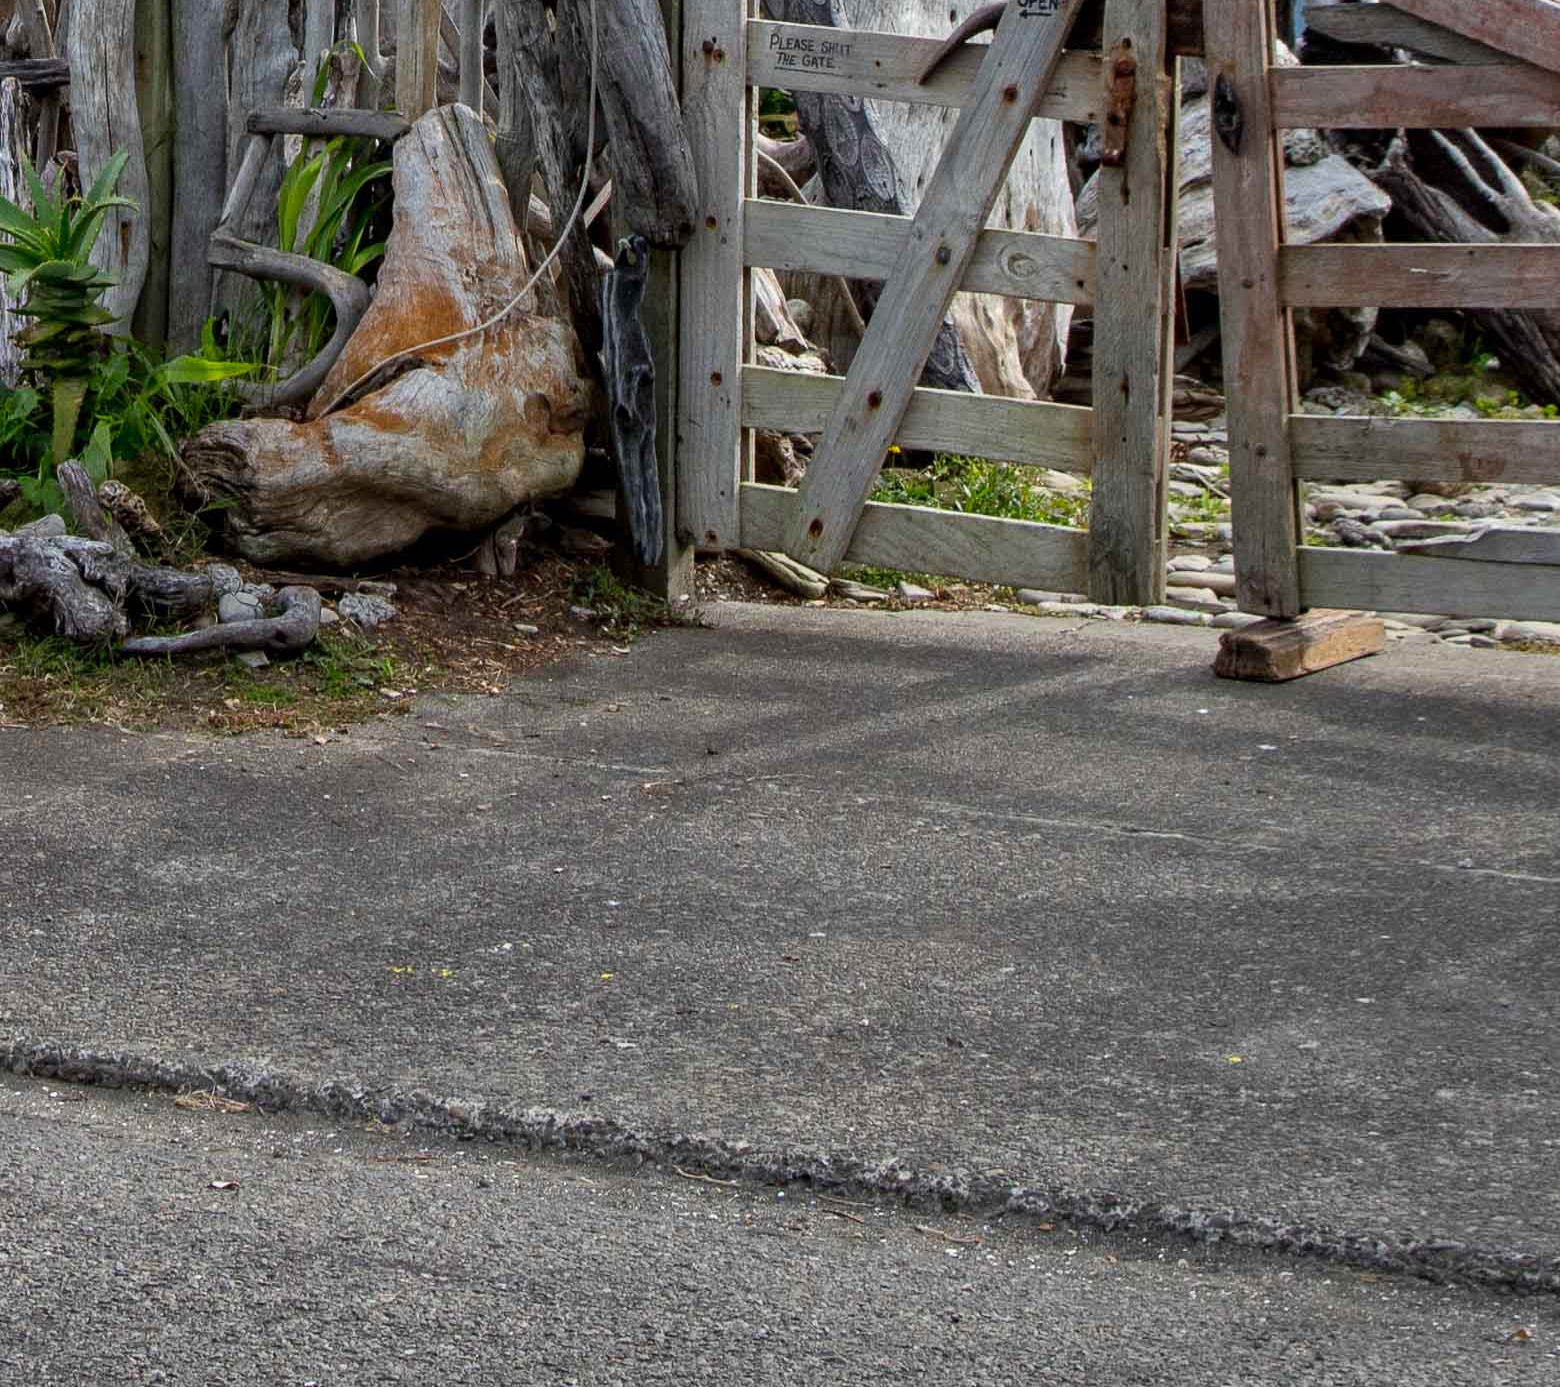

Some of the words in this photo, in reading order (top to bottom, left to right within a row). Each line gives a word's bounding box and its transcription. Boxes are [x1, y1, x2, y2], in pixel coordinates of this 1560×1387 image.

[769, 33, 815, 52] PLEASE
[820, 41, 854, 56] SHUT
[776, 51, 797, 66] THE
